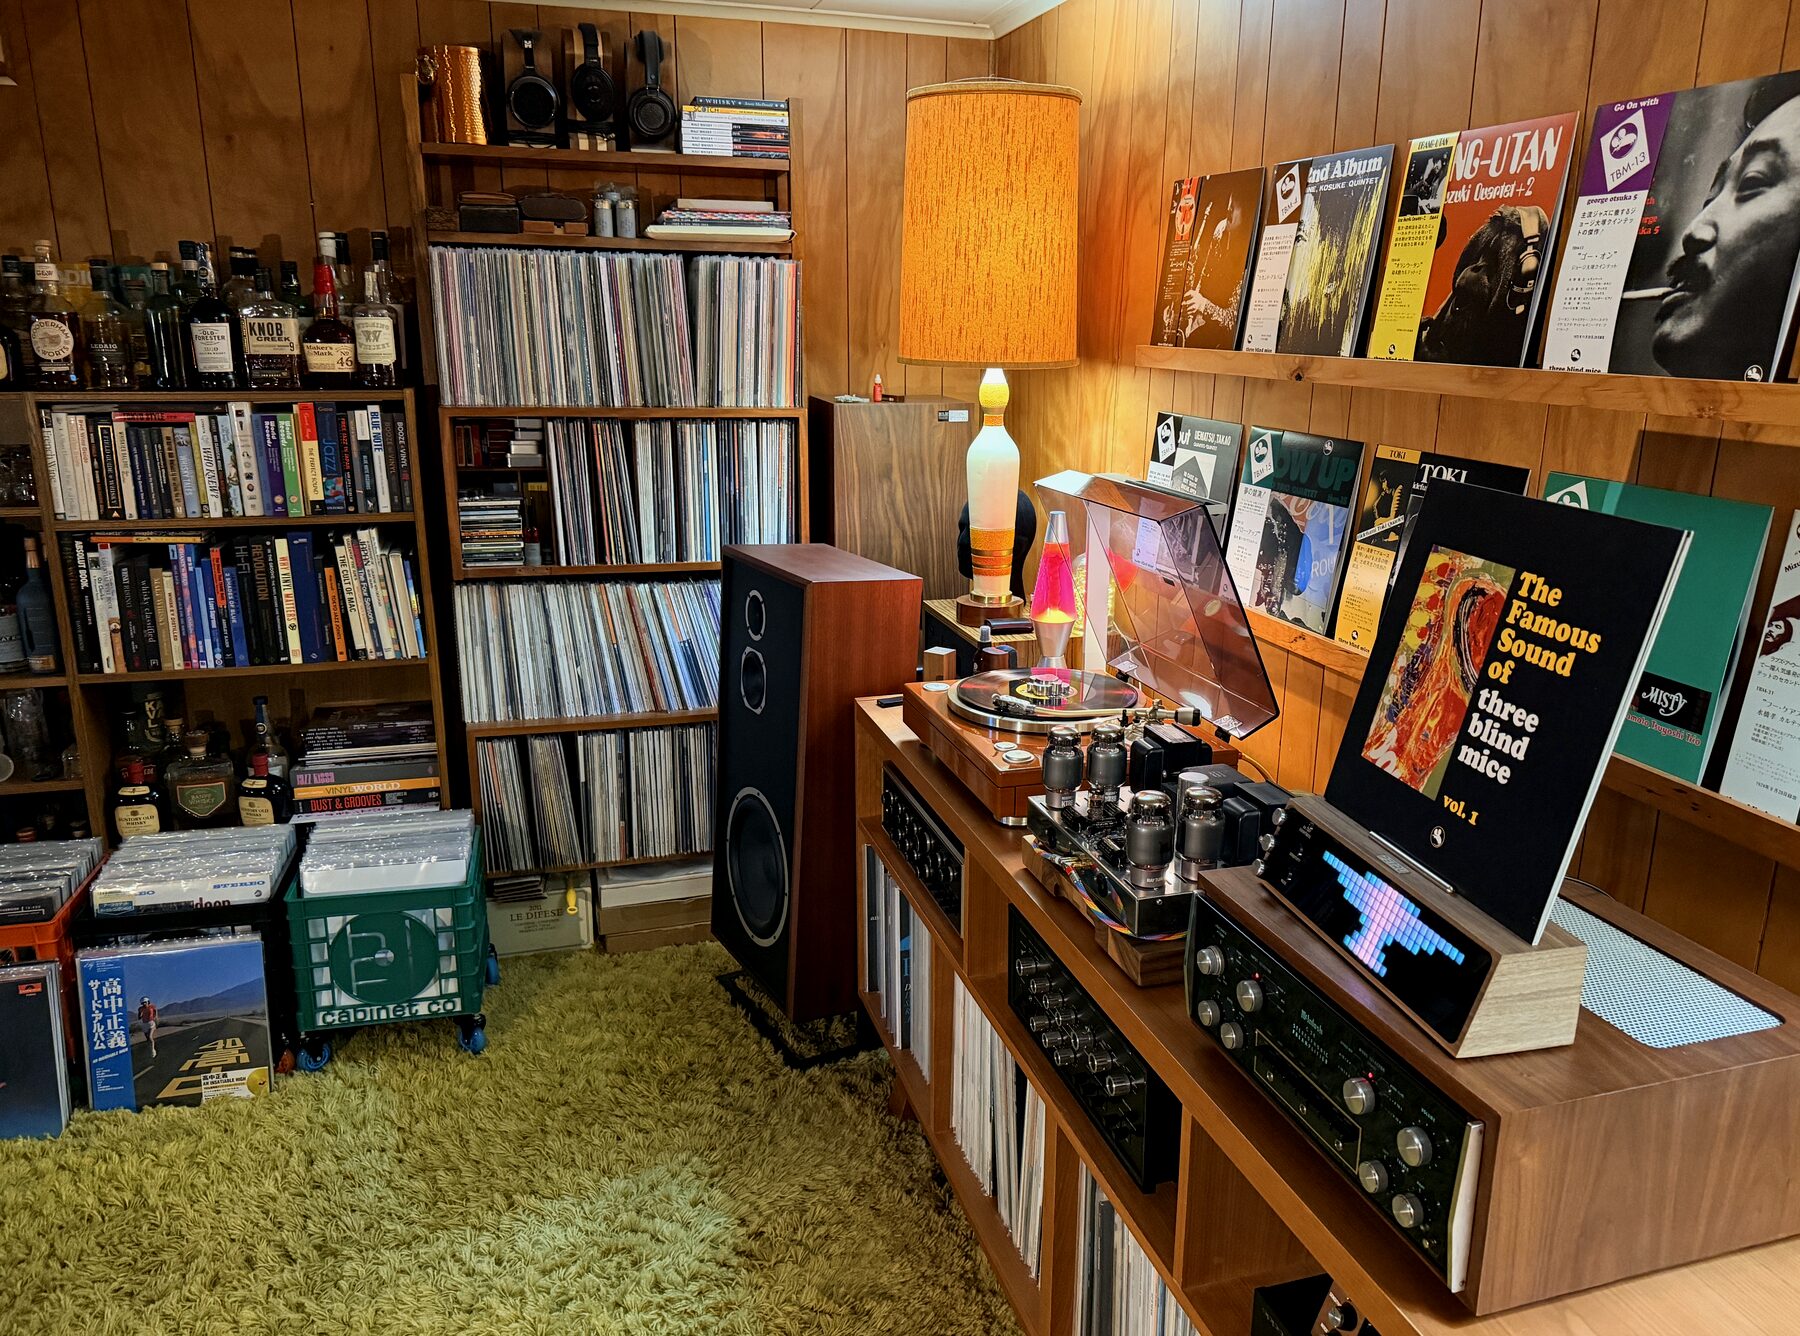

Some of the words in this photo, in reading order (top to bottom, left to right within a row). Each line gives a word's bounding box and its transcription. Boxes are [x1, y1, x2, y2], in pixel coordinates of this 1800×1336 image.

[1614, 104, 1624, 112] Go
[1626, 102, 1638, 110] On
[1640, 97, 1659, 107] with
[1332, 156, 1383, 178] Album
[1610, 152, 1646, 182] TBM-13
[1318, 182, 1346, 192] KOSUKE
[1348, 176, 1379, 188] QUINTET
[1586, 197, 1608, 206] george
[1610, 194, 1632, 202] otsuka
[32, 320, 70, 340] GOODERHAM
[249, 322, 284, 337] KNOB
[289, 342, 295, 352] 9
[336, 357, 353, 366] 46
[284, 420, 292, 440] World
[370, 411, 380, 431] BLUE
[264, 421, 272, 447] Records
[280, 421, 288, 447] Records
[372, 432, 383, 452] NOTE
[396, 422, 405, 444] BOOZE
[43, 430, 55, 460] French
[323, 438, 337, 472] Jazz
[1389, 450, 1406, 459] TOKI
[180, 455, 191, 478] WHISKY
[202, 448, 214, 468] WHO
[309, 457, 317, 477] PERFECT
[400, 448, 408, 468] VINYL
[206, 468, 219, 499] KNEW?
[1420, 464, 1468, 484] TOKI
[184, 478, 192, 496] TALES
[75, 540, 86, 568] ABSOLUT
[234, 546, 251, 574] Hi-Fi
[279, 556, 289, 570] WHY
[339, 555, 347, 568] THE
[359, 540, 371, 567] JAPAN
[80, 570, 89, 590] BOOK.
[251, 544, 269, 600] REVOLUTION
[281, 572, 292, 591] VINYL
[341, 569, 350, 586] CULT
[141, 580, 150, 606] whisky
[345, 587, 352, 595] OF
[1518, 571, 1562, 607] The
[284, 592, 296, 622] MATTERS
[347, 596, 356, 612] MAC
[360, 582, 368, 597] Four
[364, 597, 374, 624] Seasons
[144, 608, 156, 643] classified
[1506, 599, 1602, 654] Famous
[1497, 628, 1576, 677] Sound
[1488, 660, 1515, 685] of
[1478, 688, 1540, 733] three
[1642, 686, 1688, 716] MISTY
[1467, 713, 1531, 761] blind
[1686, 732, 1701, 746] Trio
[1458, 744, 1511, 785] mice
[296, 774, 312, 786] JAZZ
[310, 799, 333, 812] DUST
[335, 798, 343, 808] &
[344, 794, 382, 808] GROOVES
[1444, 795, 1466, 819] vol.
[1468, 811, 1479, 826] 1
[212, 880, 265, 889] STEREO
[526, 909, 563, 920] DIFESE
[102, 978, 127, 1048] 高中正義
[322, 1004, 418, 1025] cabinet
[428, 999, 456, 1013] co
